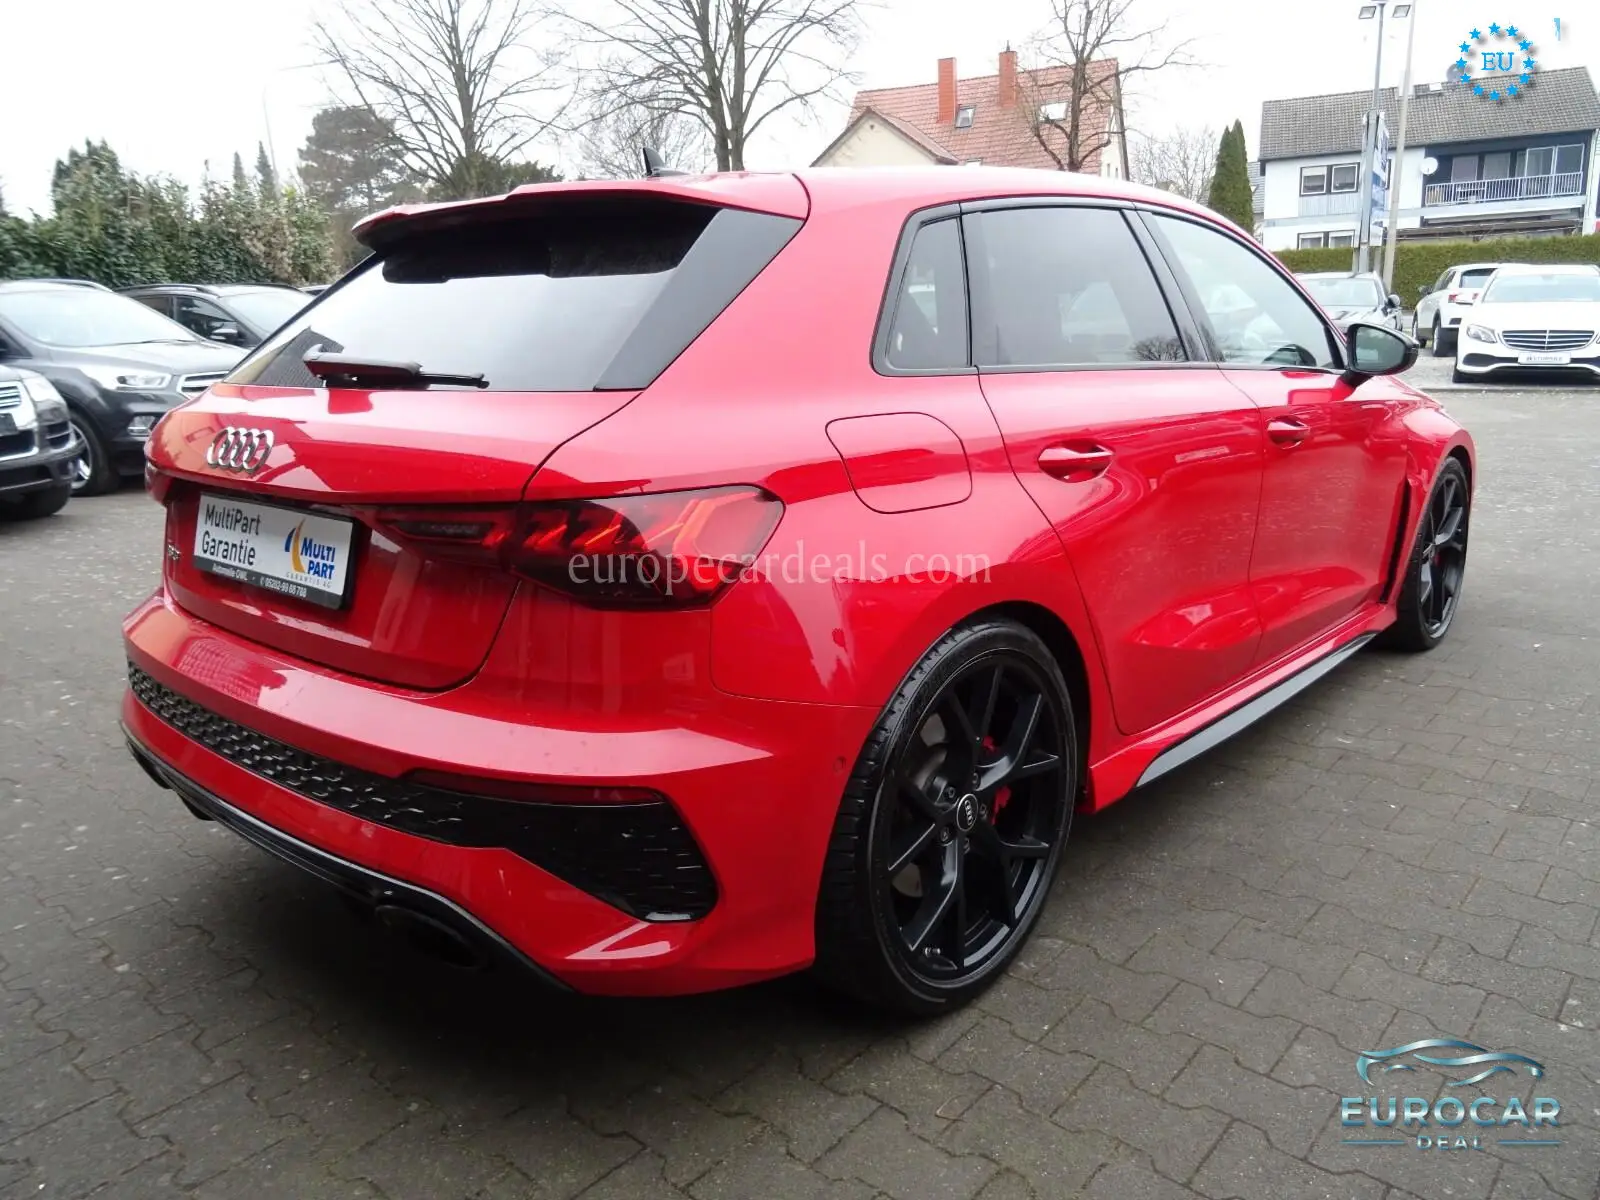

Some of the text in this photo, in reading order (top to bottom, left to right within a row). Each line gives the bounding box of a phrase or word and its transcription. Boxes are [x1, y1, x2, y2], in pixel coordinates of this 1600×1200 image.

[204, 503, 261, 536] MultiPart
[202, 530, 256, 566] Garantie
[300, 537, 336, 562] MULTI
[308, 560, 335, 580] PART
